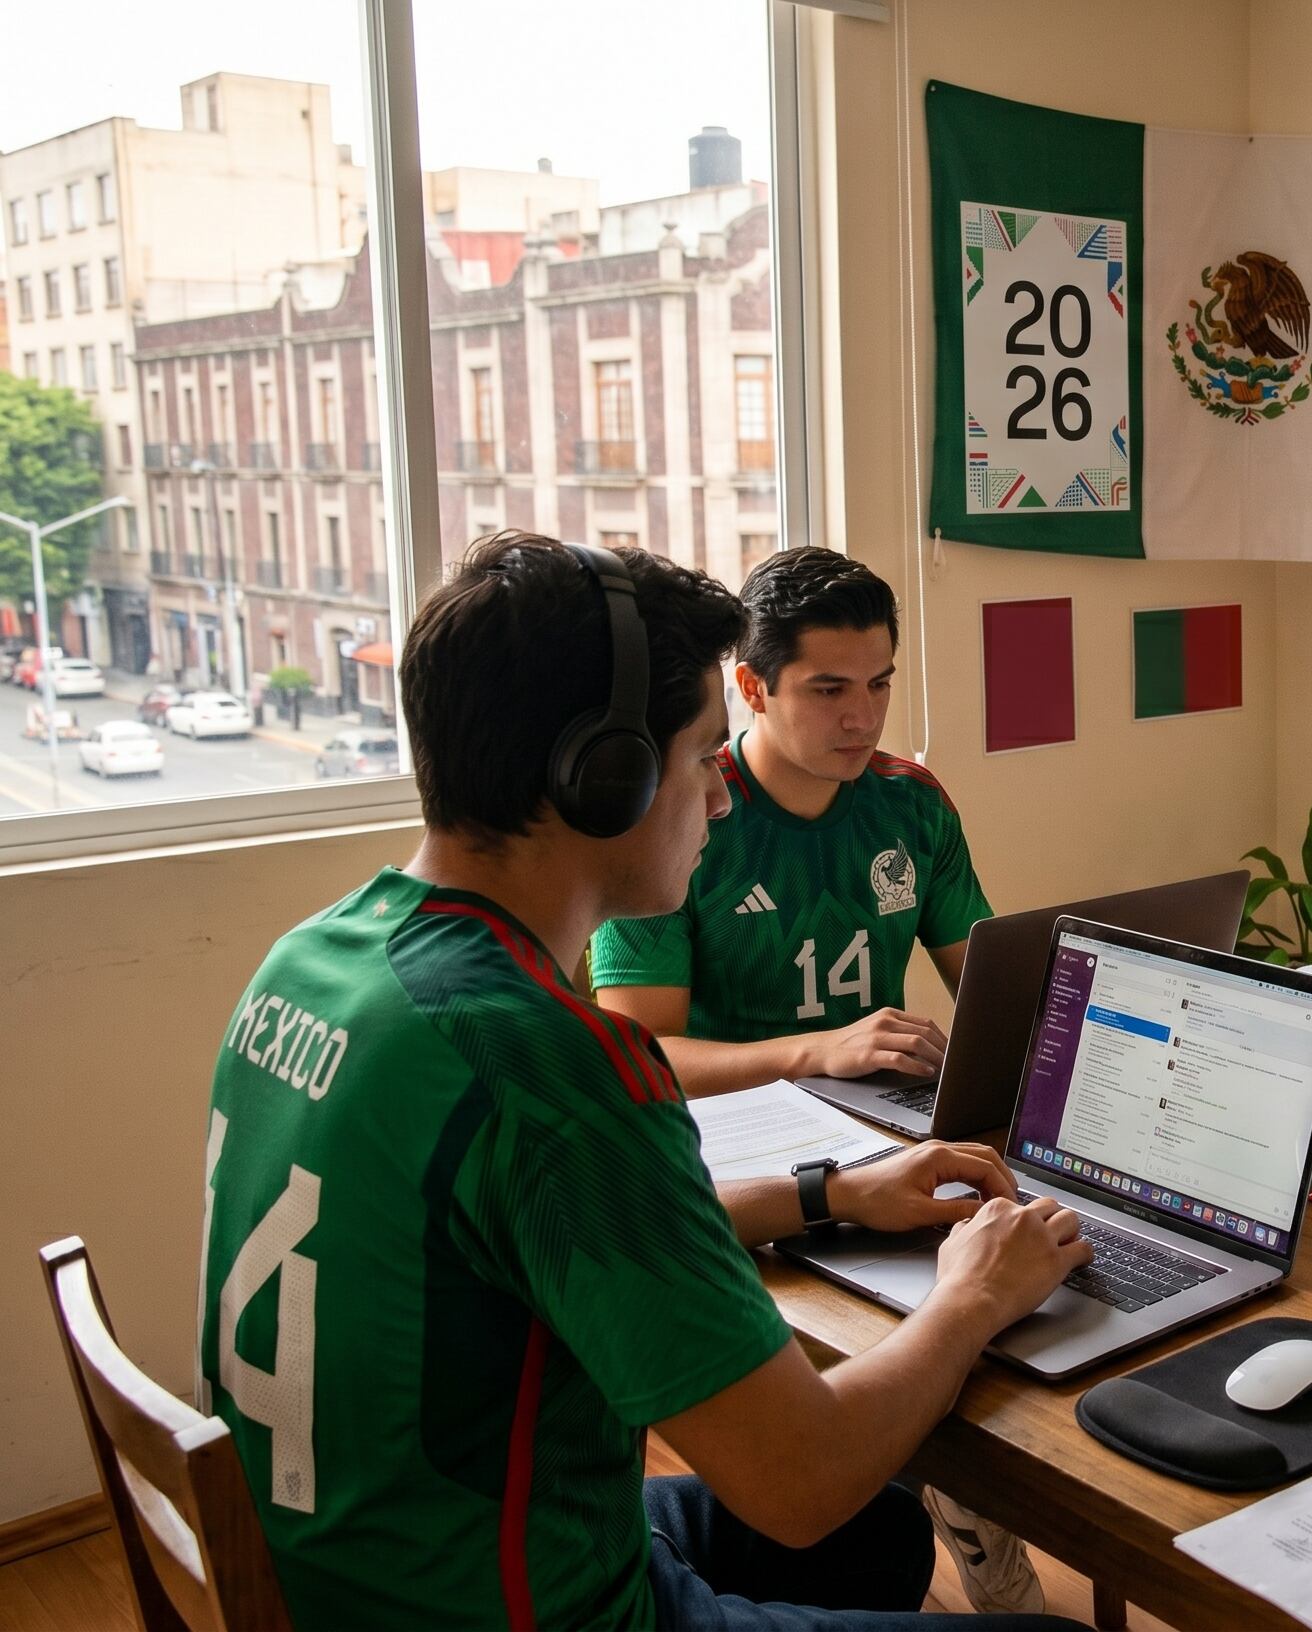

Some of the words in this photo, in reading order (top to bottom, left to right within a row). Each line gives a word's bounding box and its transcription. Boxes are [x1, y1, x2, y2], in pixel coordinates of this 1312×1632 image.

[1004, 280, 1092, 359] 20
[1006, 364, 1093, 442] 26
[794, 929, 872, 1020] 14
[194, 1107, 323, 1515] 14
